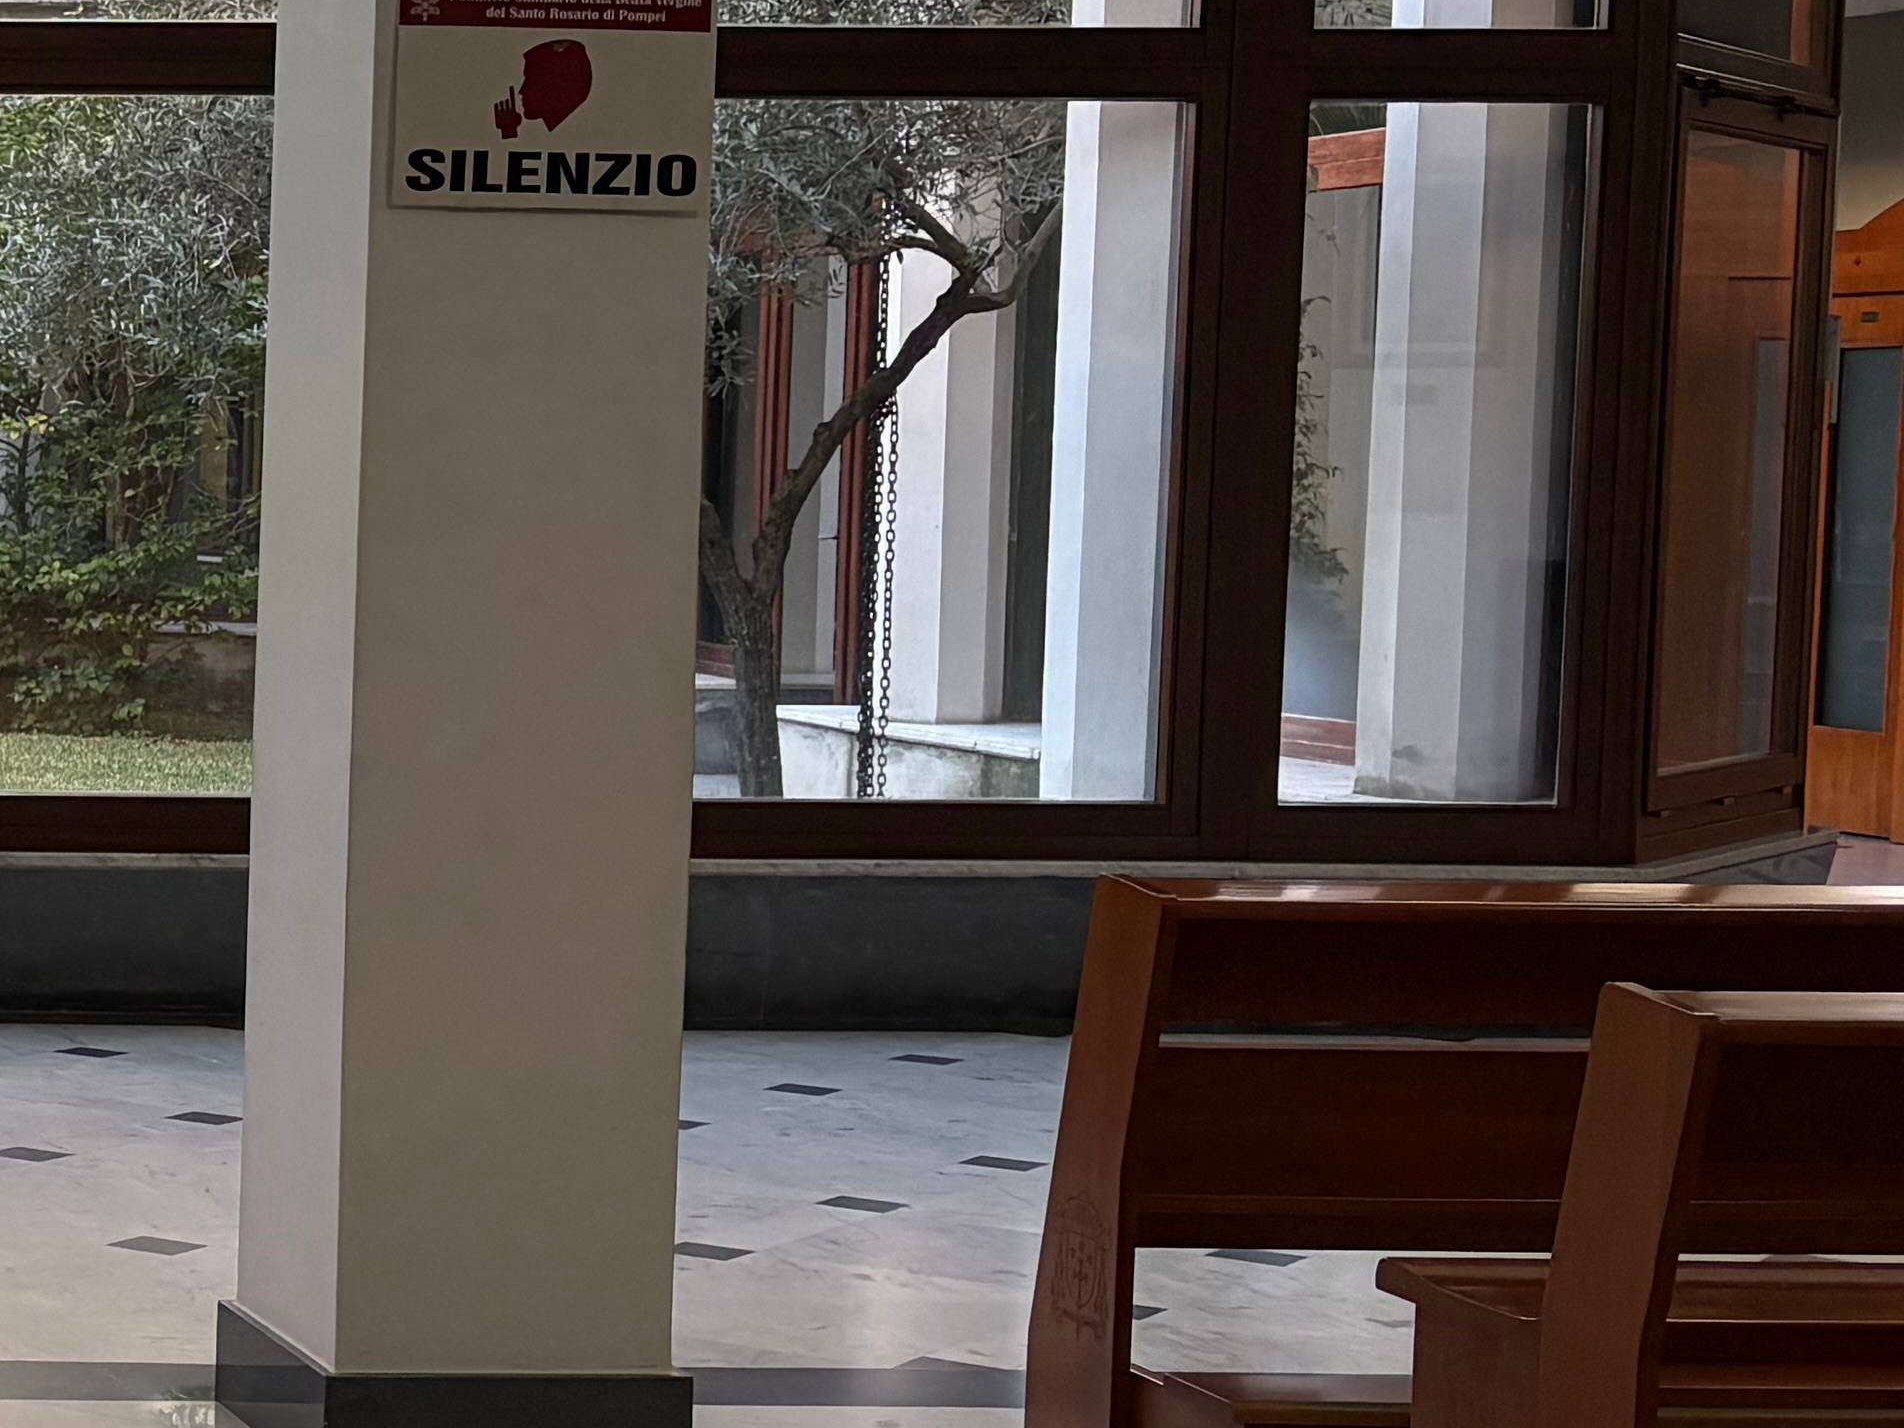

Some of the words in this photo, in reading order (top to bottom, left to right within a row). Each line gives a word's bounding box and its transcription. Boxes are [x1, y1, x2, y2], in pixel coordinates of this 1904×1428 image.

[486, 6, 505, 19] del
[509, 7, 545, 20] Santo
[549, 8, 599, 21] Rosario
[603, 8, 615, 21] di
[619, 9, 666, 23] Pompei
[405, 148, 697, 197] SILENZIO
